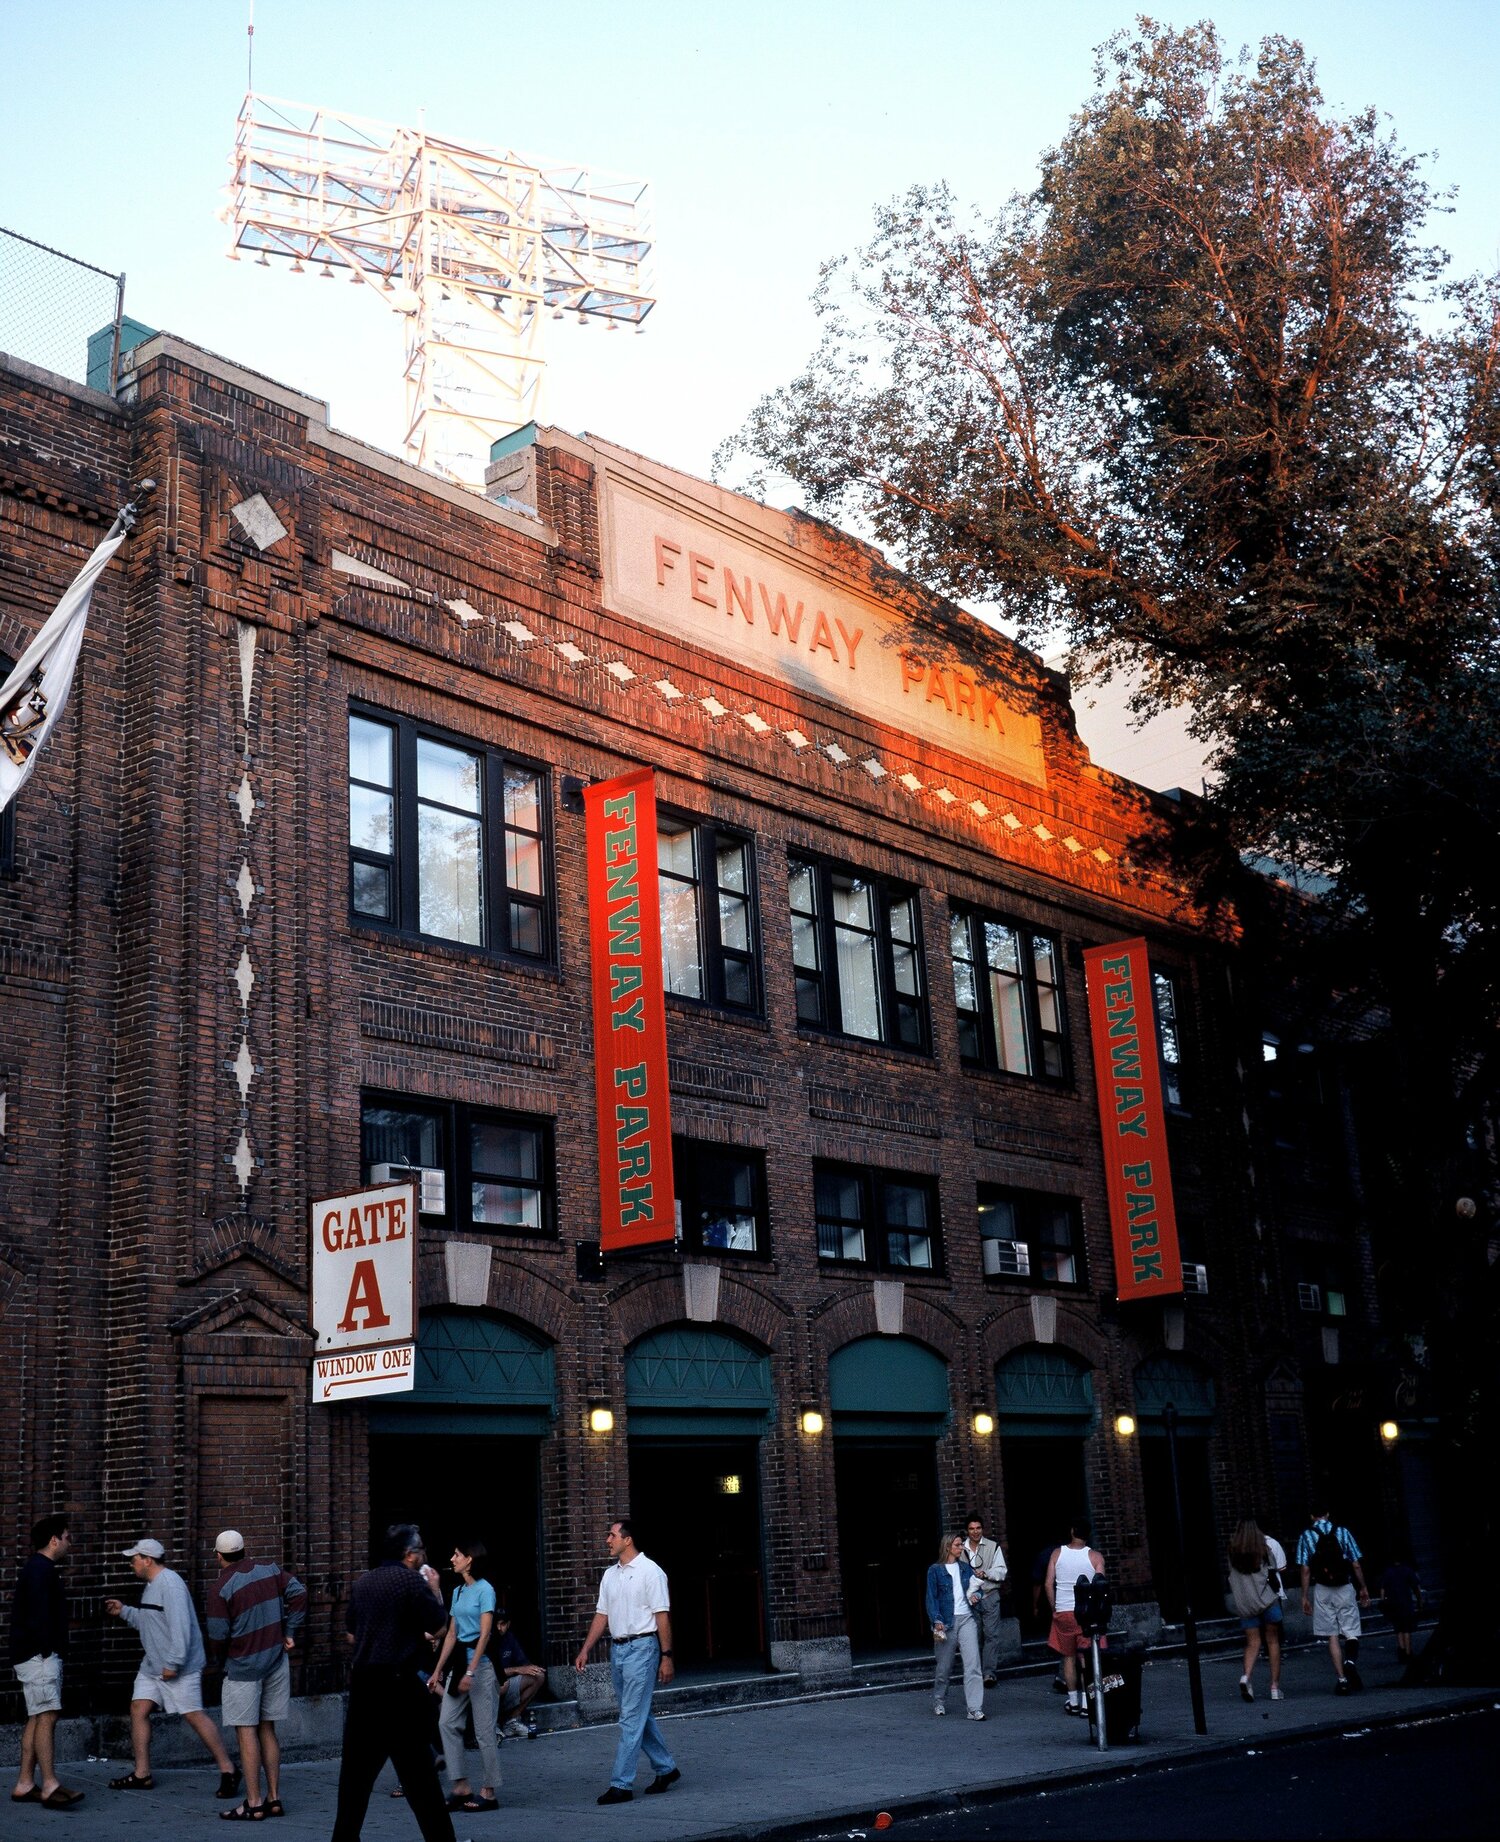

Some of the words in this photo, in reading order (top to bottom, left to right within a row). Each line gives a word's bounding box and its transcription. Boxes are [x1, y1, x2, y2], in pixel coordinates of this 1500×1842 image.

[653, 534, 864, 670] FENWAY
[899, 646, 1006, 735] PARK
[603, 790, 645, 1034] FENWAY
[1102, 954, 1149, 1138] FENWAY
[614, 1061, 655, 1228] PARK
[322, 1198, 406, 1252] GATE
[1122, 1159, 1165, 1285] PARK
[316, 1353, 377, 1379] WINDOW
[382, 1348, 412, 1370] ONE
[336, 1258, 391, 1334] A
